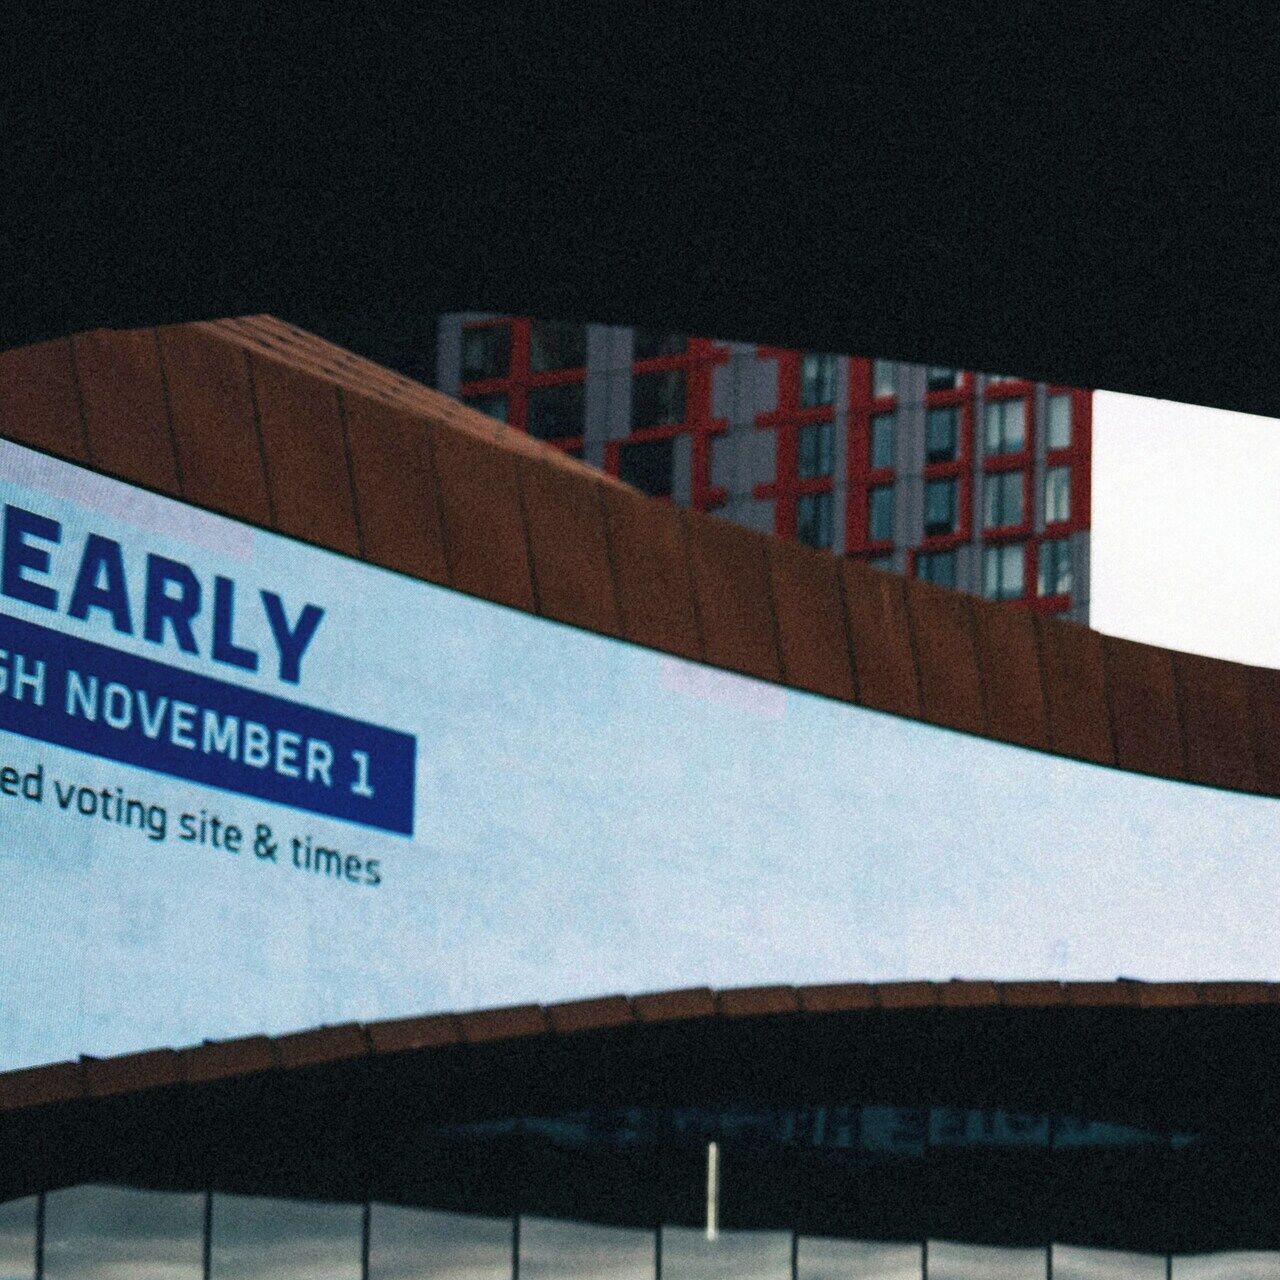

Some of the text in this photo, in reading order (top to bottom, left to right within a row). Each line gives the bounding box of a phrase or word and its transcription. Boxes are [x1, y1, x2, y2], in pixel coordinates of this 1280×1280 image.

[1, 503, 326, 686] EARLY
[66, 669, 335, 787] NOVEMBER
[350, 750, 375, 798] 1
[54, 779, 167, 842] voting
[178, 808, 243, 854] site
[253, 824, 279, 864] &
[291, 835, 382, 887] times
